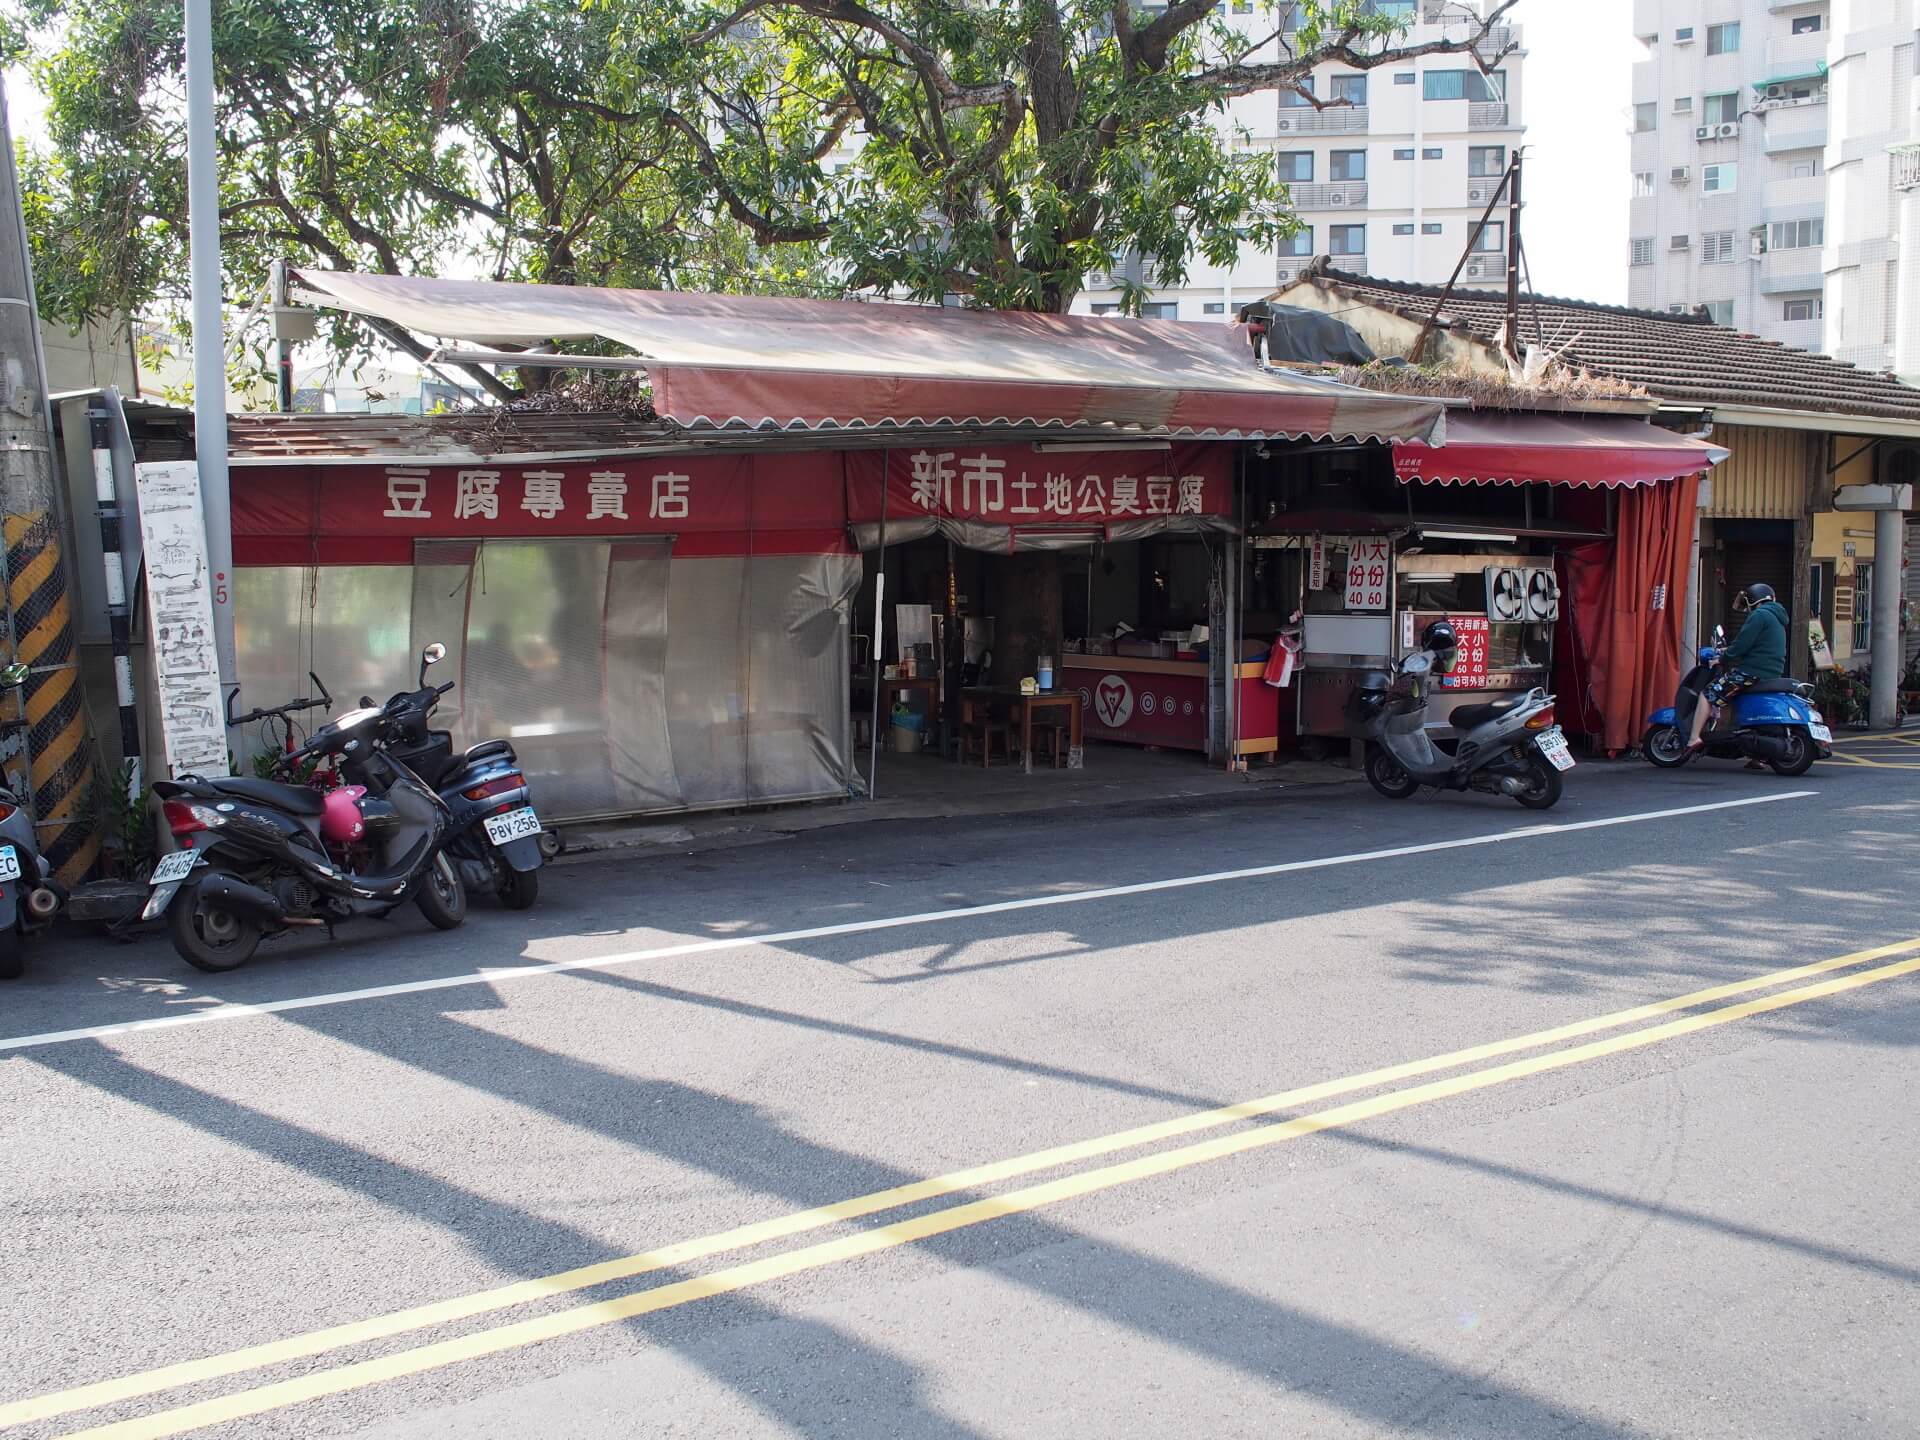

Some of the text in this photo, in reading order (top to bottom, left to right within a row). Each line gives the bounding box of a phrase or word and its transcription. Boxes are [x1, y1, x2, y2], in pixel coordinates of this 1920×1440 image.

[910, 450, 1205, 515] 新市土地公臭豆腐
[383, 467, 691, 520] 豆腐專賣店
[216, 585, 228, 604] 5
[1349, 592, 1362, 605] 40
[1368, 592, 1382, 605] 60
[1457, 665, 1467, 673] 60
[1472, 665, 1483, 673] 40
[489, 816, 538, 841] P8V-256
